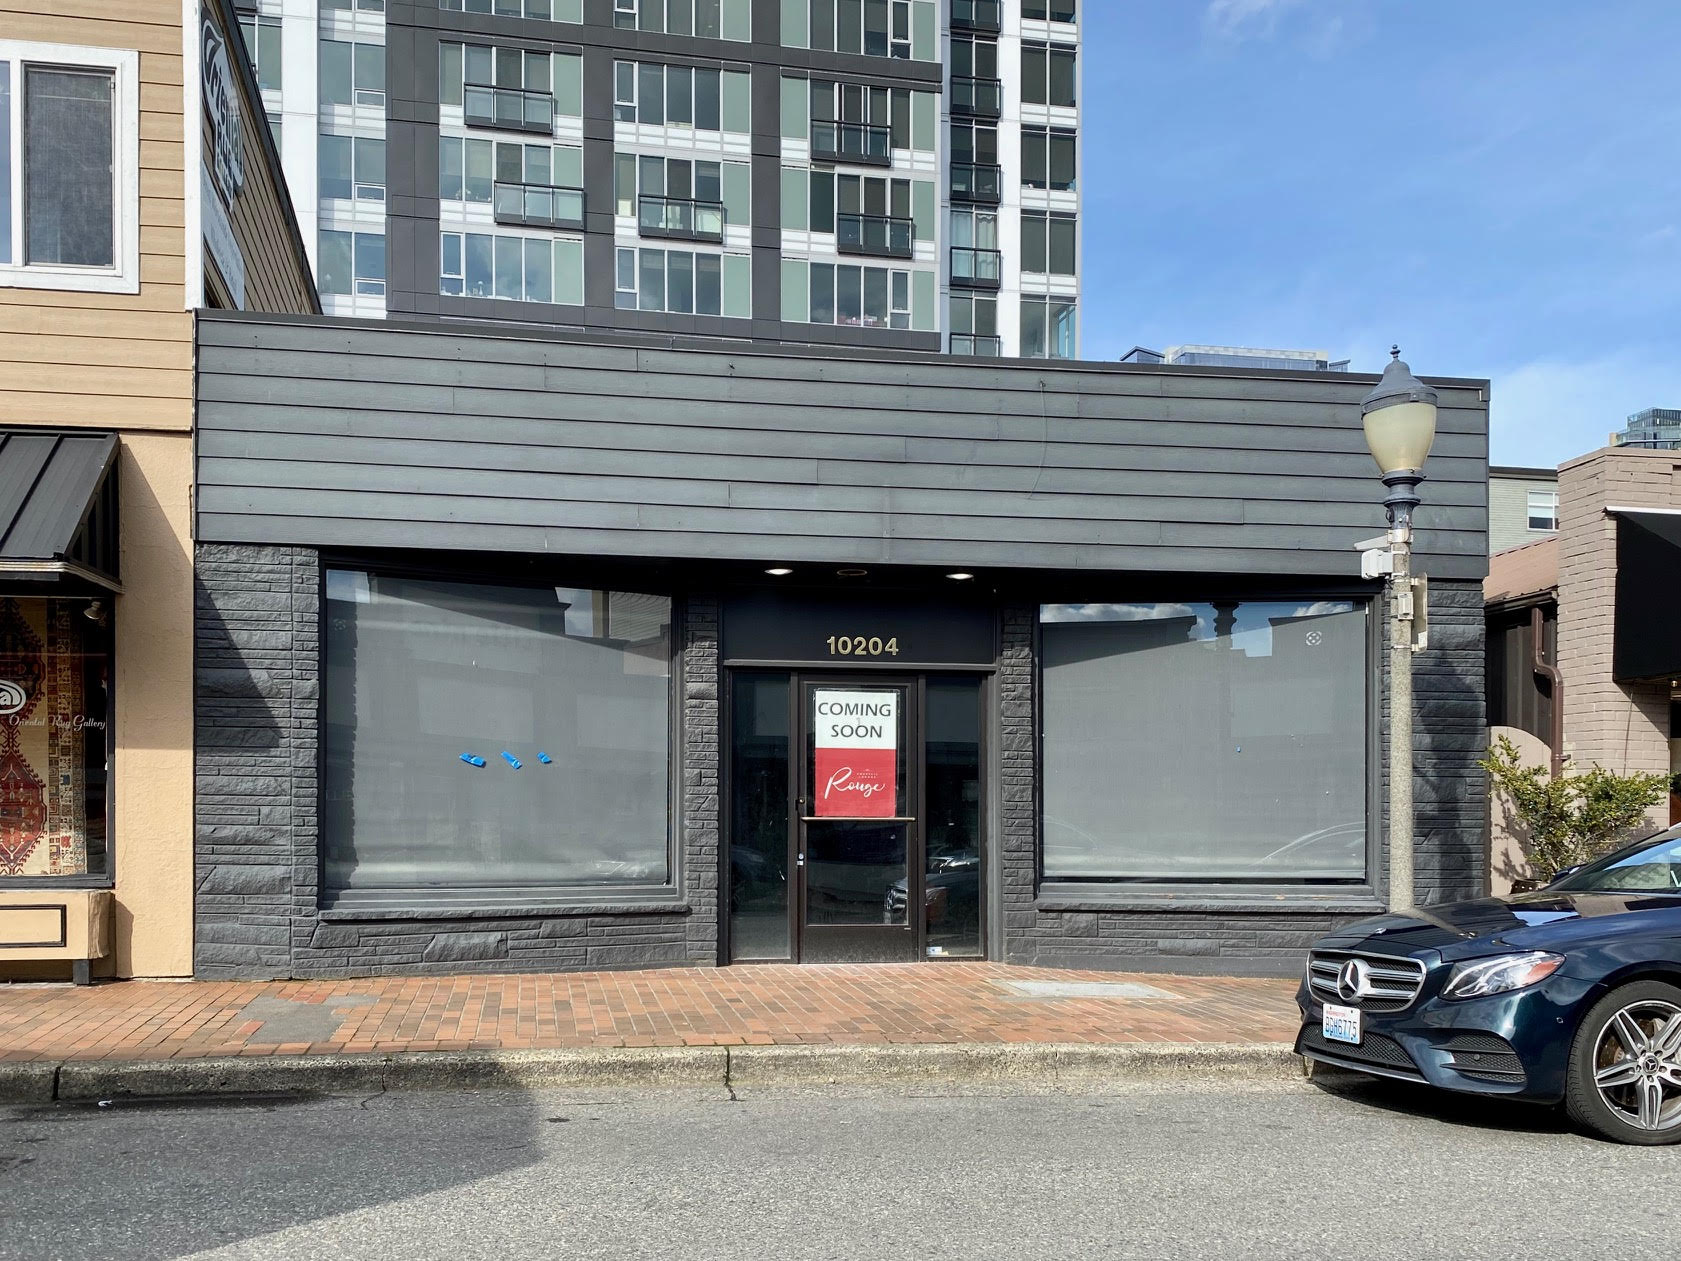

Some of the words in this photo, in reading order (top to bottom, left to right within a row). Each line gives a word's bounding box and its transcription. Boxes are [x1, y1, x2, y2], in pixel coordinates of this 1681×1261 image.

[826, 636, 899, 656] 10204
[818, 702, 891, 717] COMING
[73, 714, 106, 731] Gallery
[831, 724, 883, 738] SOON
[824, 766, 886, 800] Rouge
